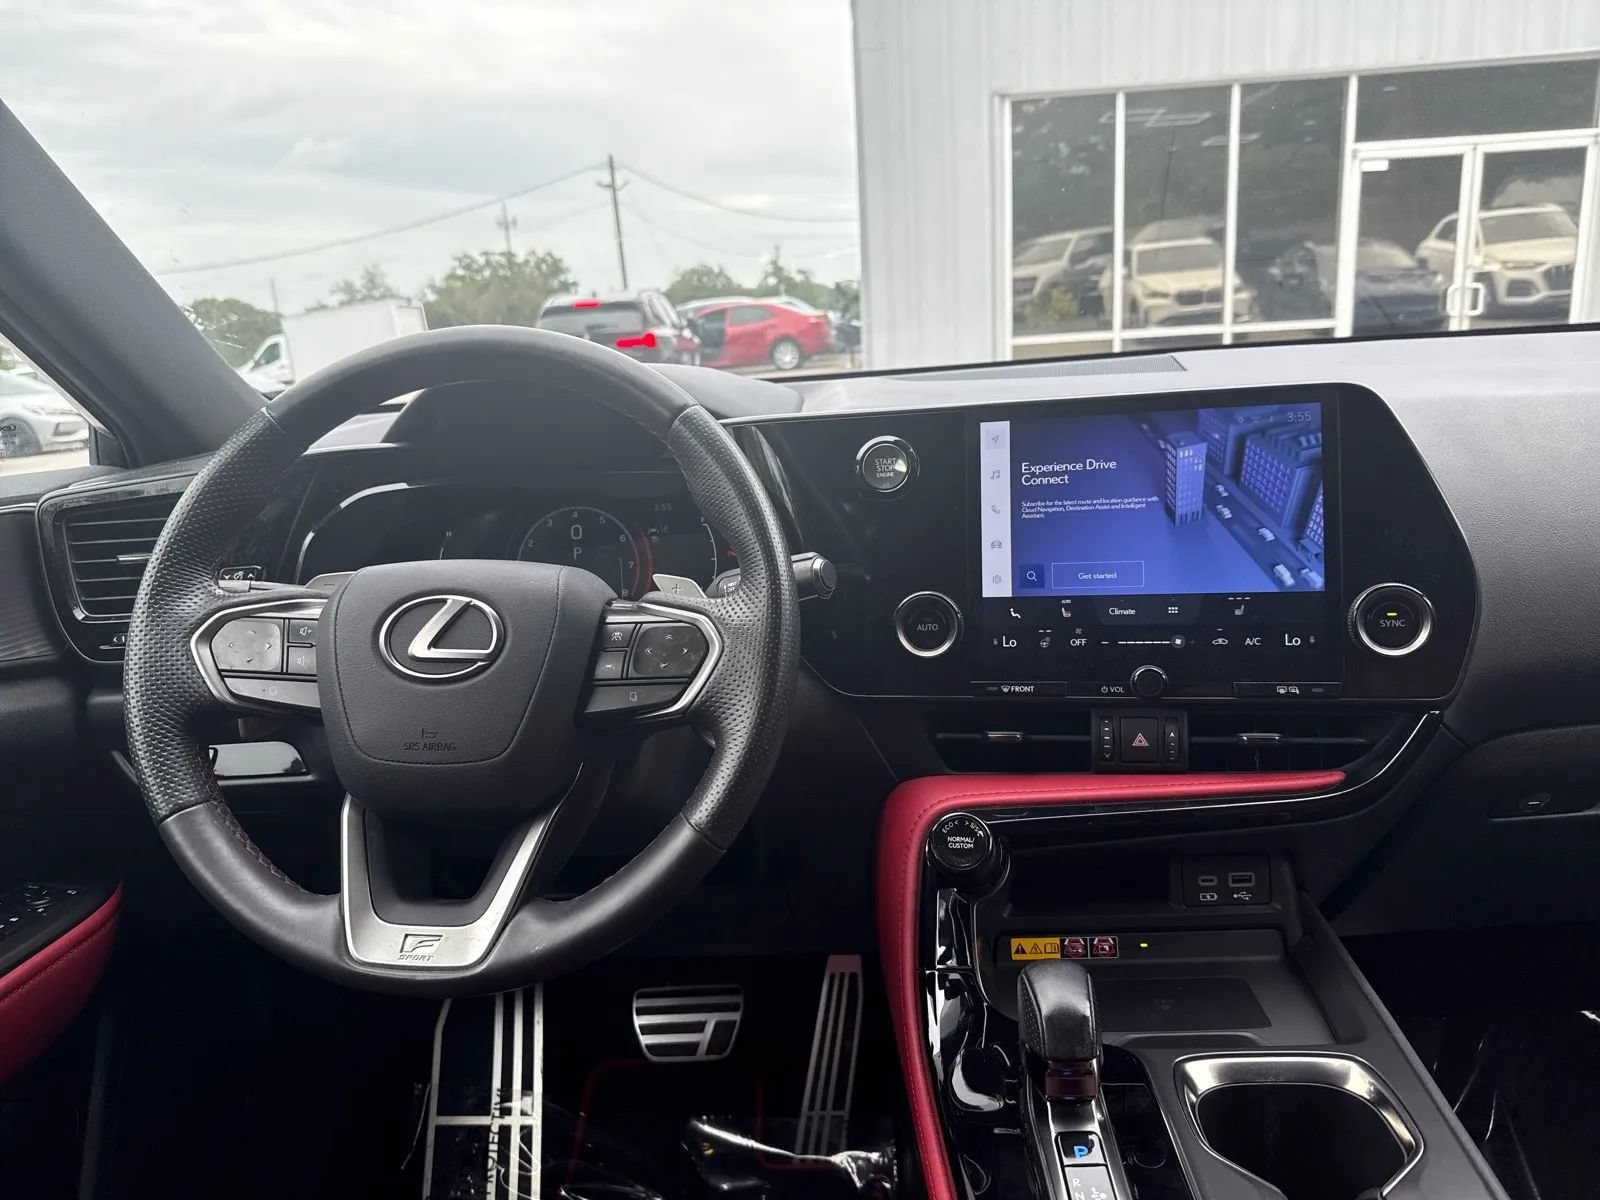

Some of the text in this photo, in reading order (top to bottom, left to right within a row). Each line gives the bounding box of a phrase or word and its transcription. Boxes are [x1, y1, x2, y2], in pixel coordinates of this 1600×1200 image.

[1287, 411, 1312, 422] 3:55
[1021, 459, 1117, 475] Experience Drive
[1021, 474, 1069, 486] Connect
[547, 519, 553, 527] 3
[600, 516, 606, 524] 5
[570, 524, 583, 540] 0
[619, 534, 626, 542] 6
[528, 539, 534, 547] 2
[573, 547, 582, 560] P
[628, 561, 634, 569] 7
[1078, 571, 1117, 580] Get started
[1109, 607, 1136, 615] Climate
[917, 623, 939, 631] AUTO
[1379, 619, 1406, 627] SYNC
[1002, 635, 1017, 647] Lo
[1070, 638, 1087, 647] OFF
[1245, 637, 1261, 646] A/C
[1285, 633, 1301, 646] Lo
[1011, 685, 1035, 693] FRONT
[403, 742, 456, 751] SRS AIRBAG
[941, 822, 954, 834] ECO
[398, 954, 435, 962] SPORT
[1073, 1145, 1089, 1161] P
[1072, 1177, 1081, 1187] R
[1074, 1191, 1085, 1200] N
